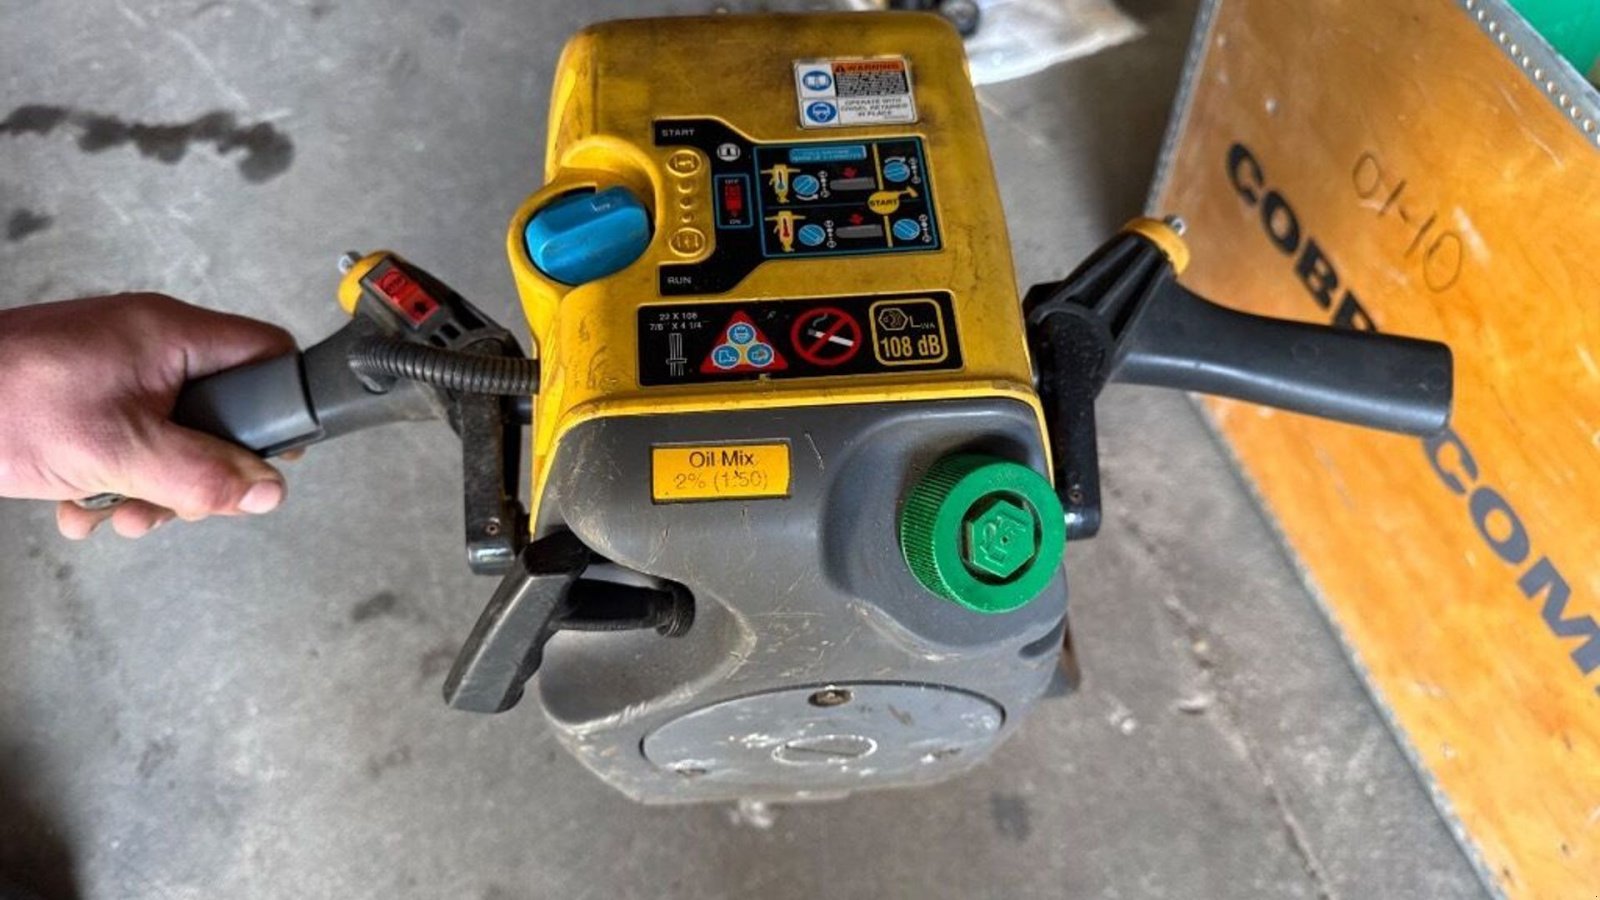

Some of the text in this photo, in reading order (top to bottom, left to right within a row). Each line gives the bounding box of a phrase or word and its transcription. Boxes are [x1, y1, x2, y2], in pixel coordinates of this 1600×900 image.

[848, 62, 901, 71] WARNING
[661, 128, 695, 137] START
[667, 276, 692, 285] RUN
[880, 333, 941, 358] 108 dB
[1226, 143, 1600, 697] COB COM
[689, 450, 755, 468] Oil Mix
[674, 470, 768, 493] 2% (1:50)
